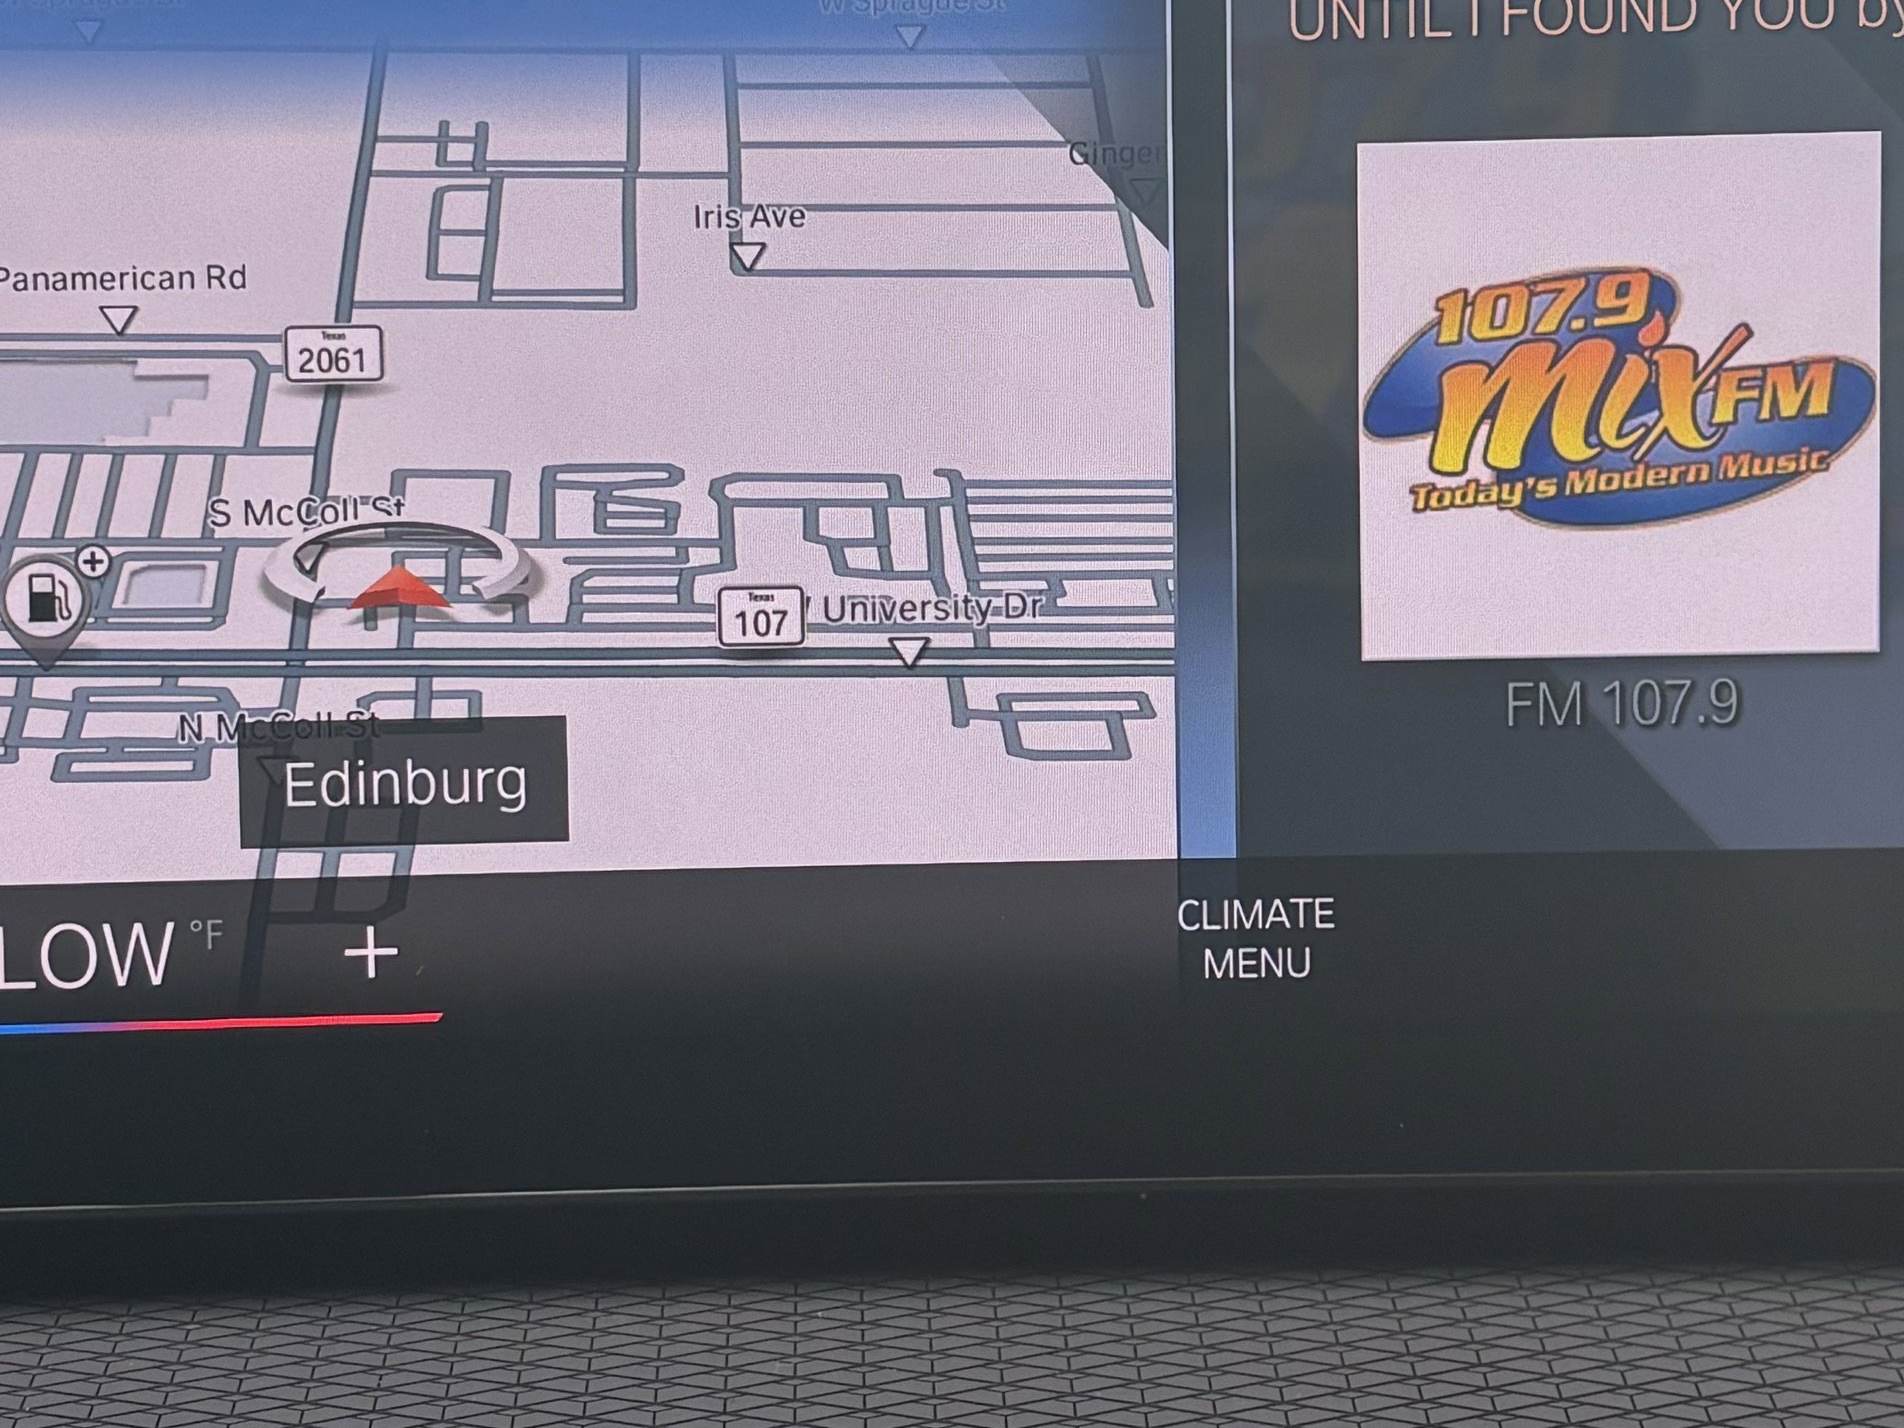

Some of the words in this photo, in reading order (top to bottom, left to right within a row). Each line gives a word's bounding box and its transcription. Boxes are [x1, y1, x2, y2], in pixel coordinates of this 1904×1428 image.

[695, 203, 742, 231] Iris
[750, 203, 807, 230] Ave
[205, 263, 248, 291] Rd
[1434, 268, 1652, 346] 107.9
[321, 331, 346, 342] Texas
[298, 347, 365, 374] 2061
[1710, 357, 1839, 425] FM
[1409, 471, 1558, 513] Today's
[1563, 460, 1711, 499] Modern
[1717, 445, 1833, 483] Music
[209, 498, 232, 527] S
[243, 497, 359, 527] McColl
[371, 496, 406, 518] St
[748, 592, 775, 603] Texas
[823, 592, 993, 626] University
[1004, 592, 1043, 620] Dr
[735, 609, 789, 637] 107
[1506, 680, 1583, 727] FM
[1602, 677, 1743, 726] 107.9
[178, 713, 203, 741] N
[216, 712, 333, 741] McColl
[345, 711, 382, 739] St
[285, 758, 528, 813] Edinburg
[1176, 897, 1336, 932] CLIMATE
[1203, 946, 1312, 979] MENU
